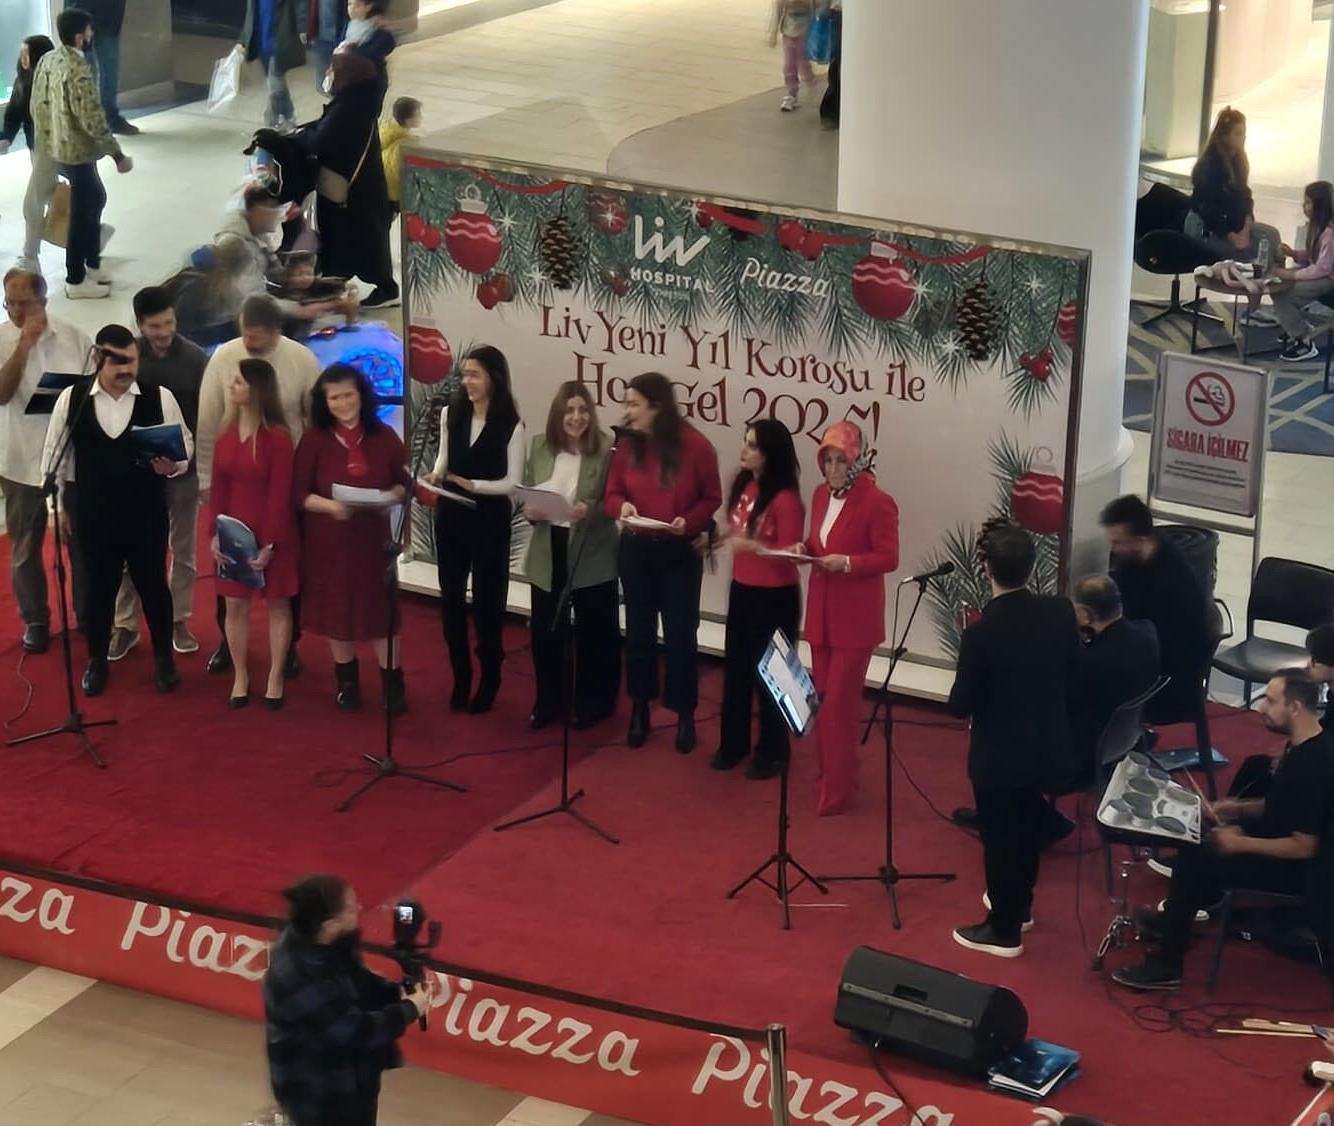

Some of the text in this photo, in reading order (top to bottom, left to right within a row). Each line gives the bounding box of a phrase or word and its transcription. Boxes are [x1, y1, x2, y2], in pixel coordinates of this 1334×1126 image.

[630, 267, 715, 293] HOSPITAL
[740, 257, 830, 298] Piazza
[539, 304, 592, 344] Liv
[593, 308, 666, 356] Yeni
[743, 336, 873, 395] Korosu
[572, 351, 628, 407] Ho
[672, 376, 731, 427] Gel
[121, 900, 268, 982] Piaz
